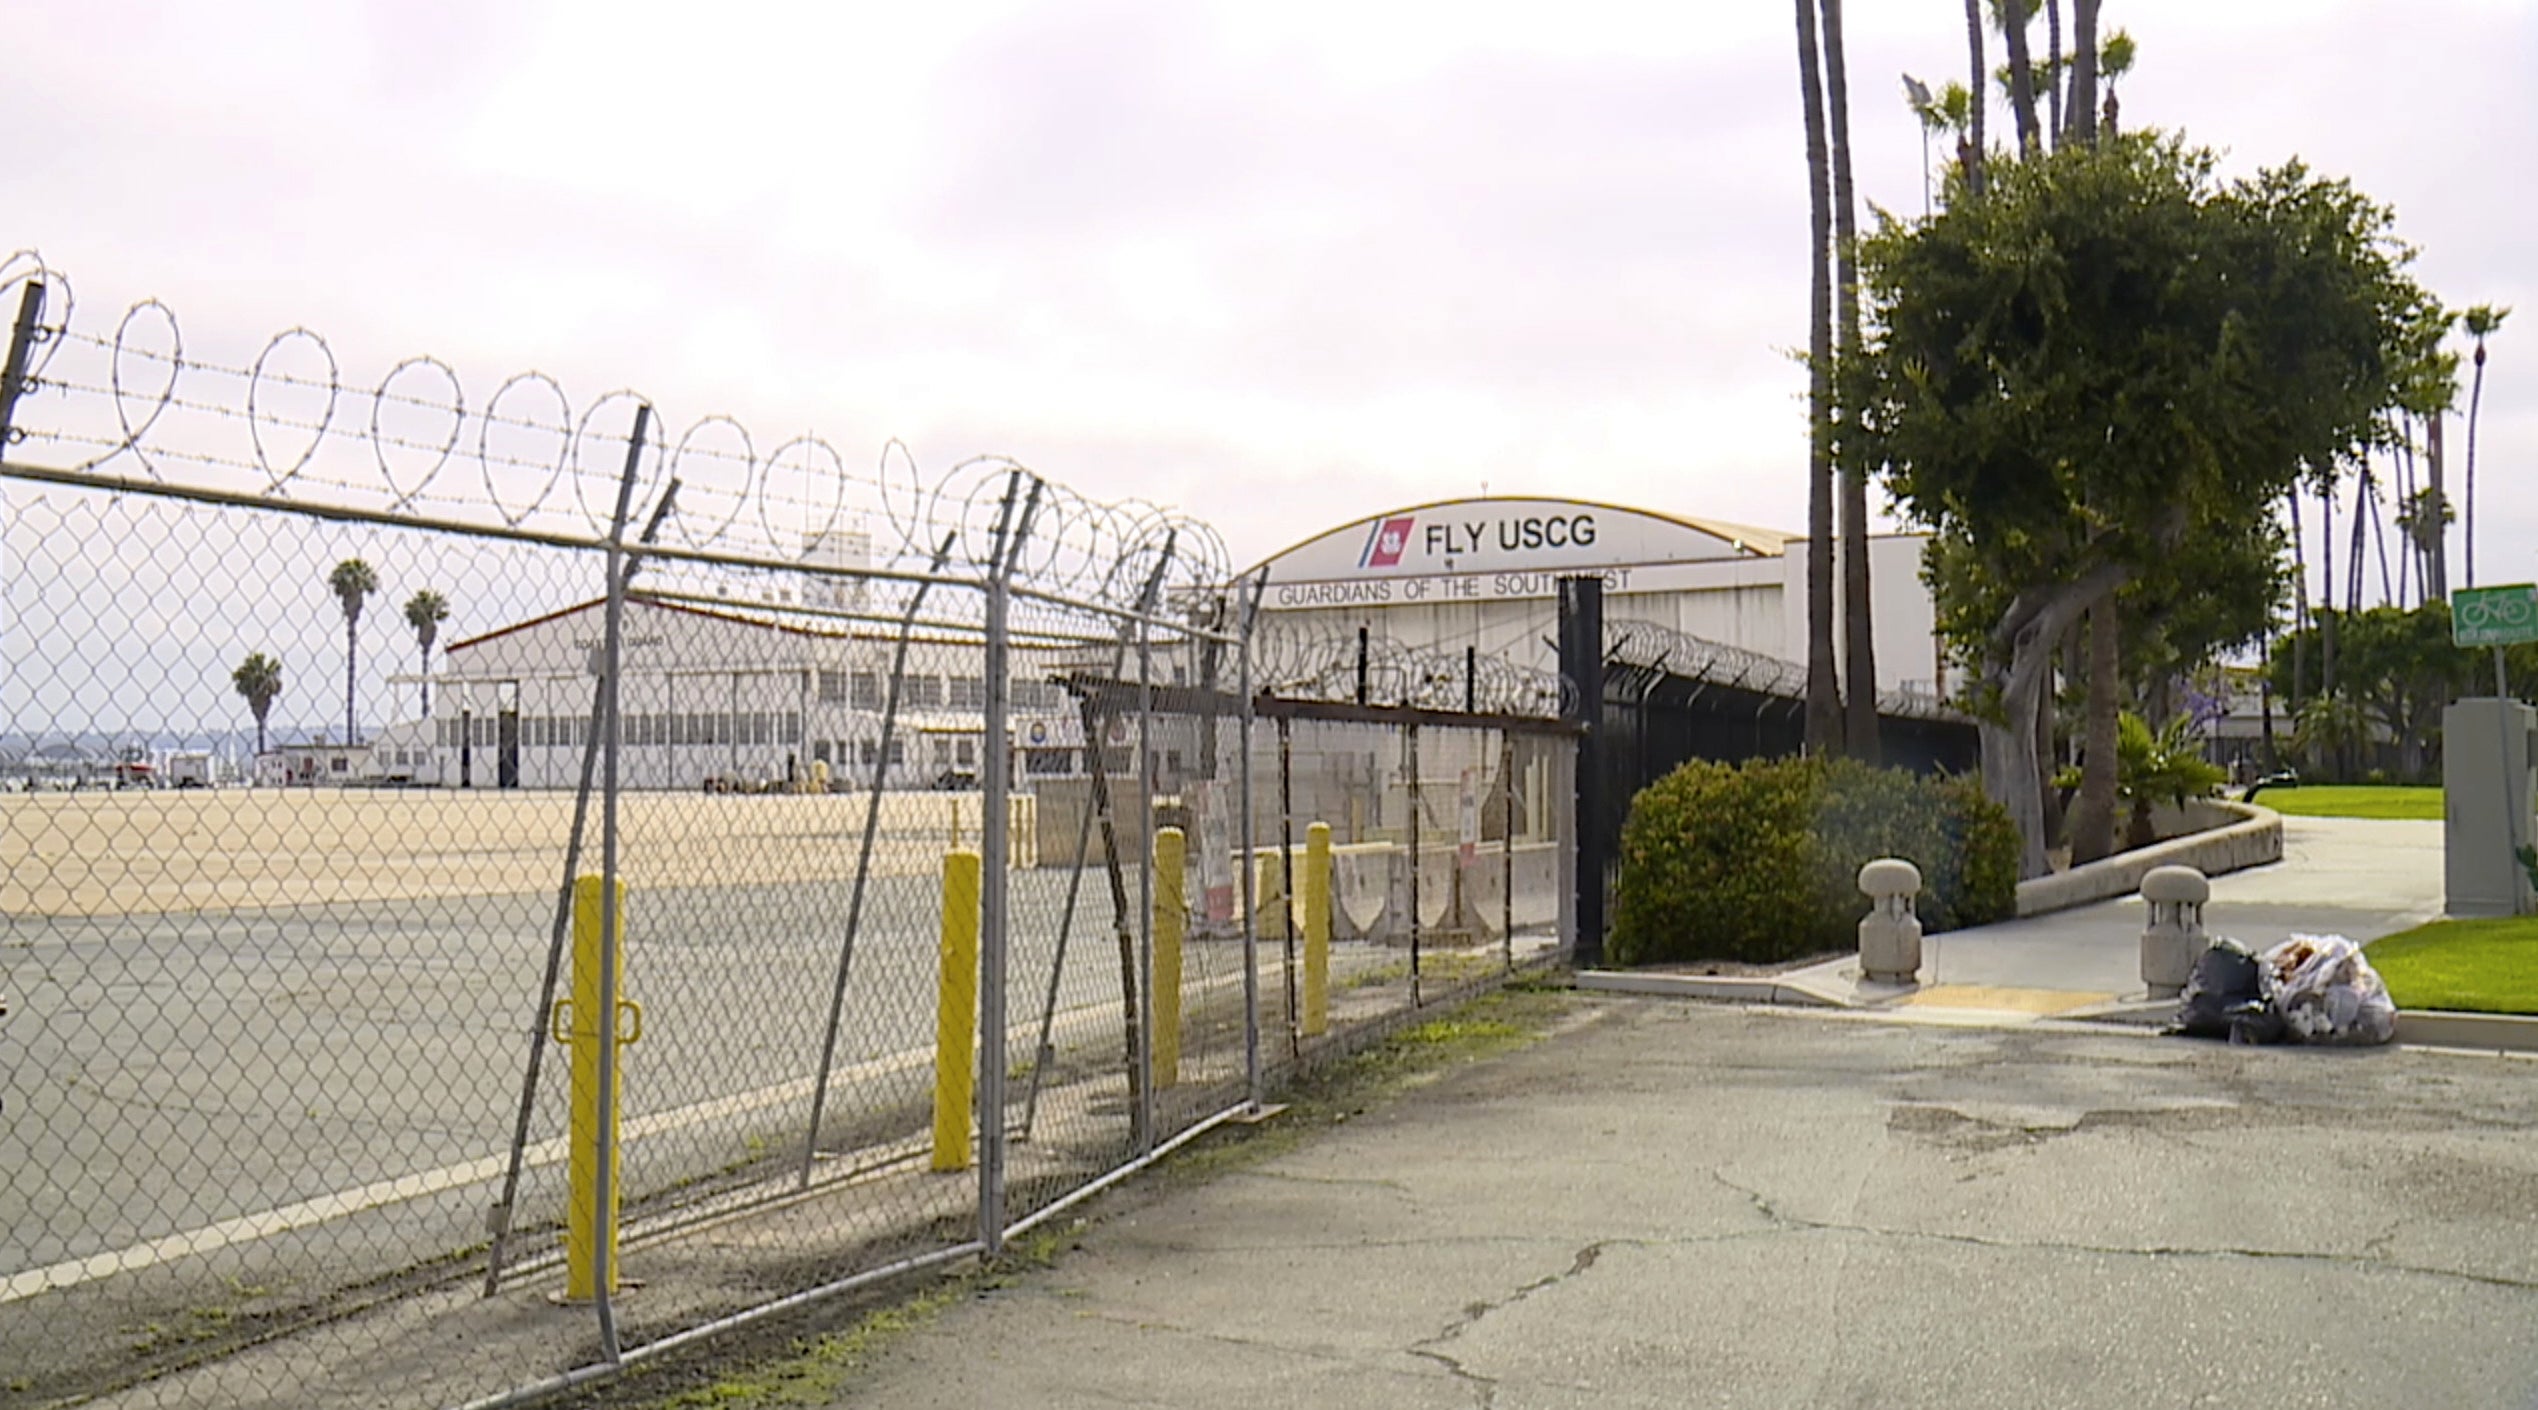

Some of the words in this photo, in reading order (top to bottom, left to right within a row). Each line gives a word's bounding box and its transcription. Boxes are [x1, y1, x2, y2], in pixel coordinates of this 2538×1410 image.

[1426, 521, 1486, 555] FLY
[1499, 514, 1596, 551] USCG
[1278, 581, 1392, 606] GUARDIANS
[1403, 578, 1431, 601] OF
[1442, 575, 1480, 598] THE
[1494, 568, 1632, 595] SOUTST
